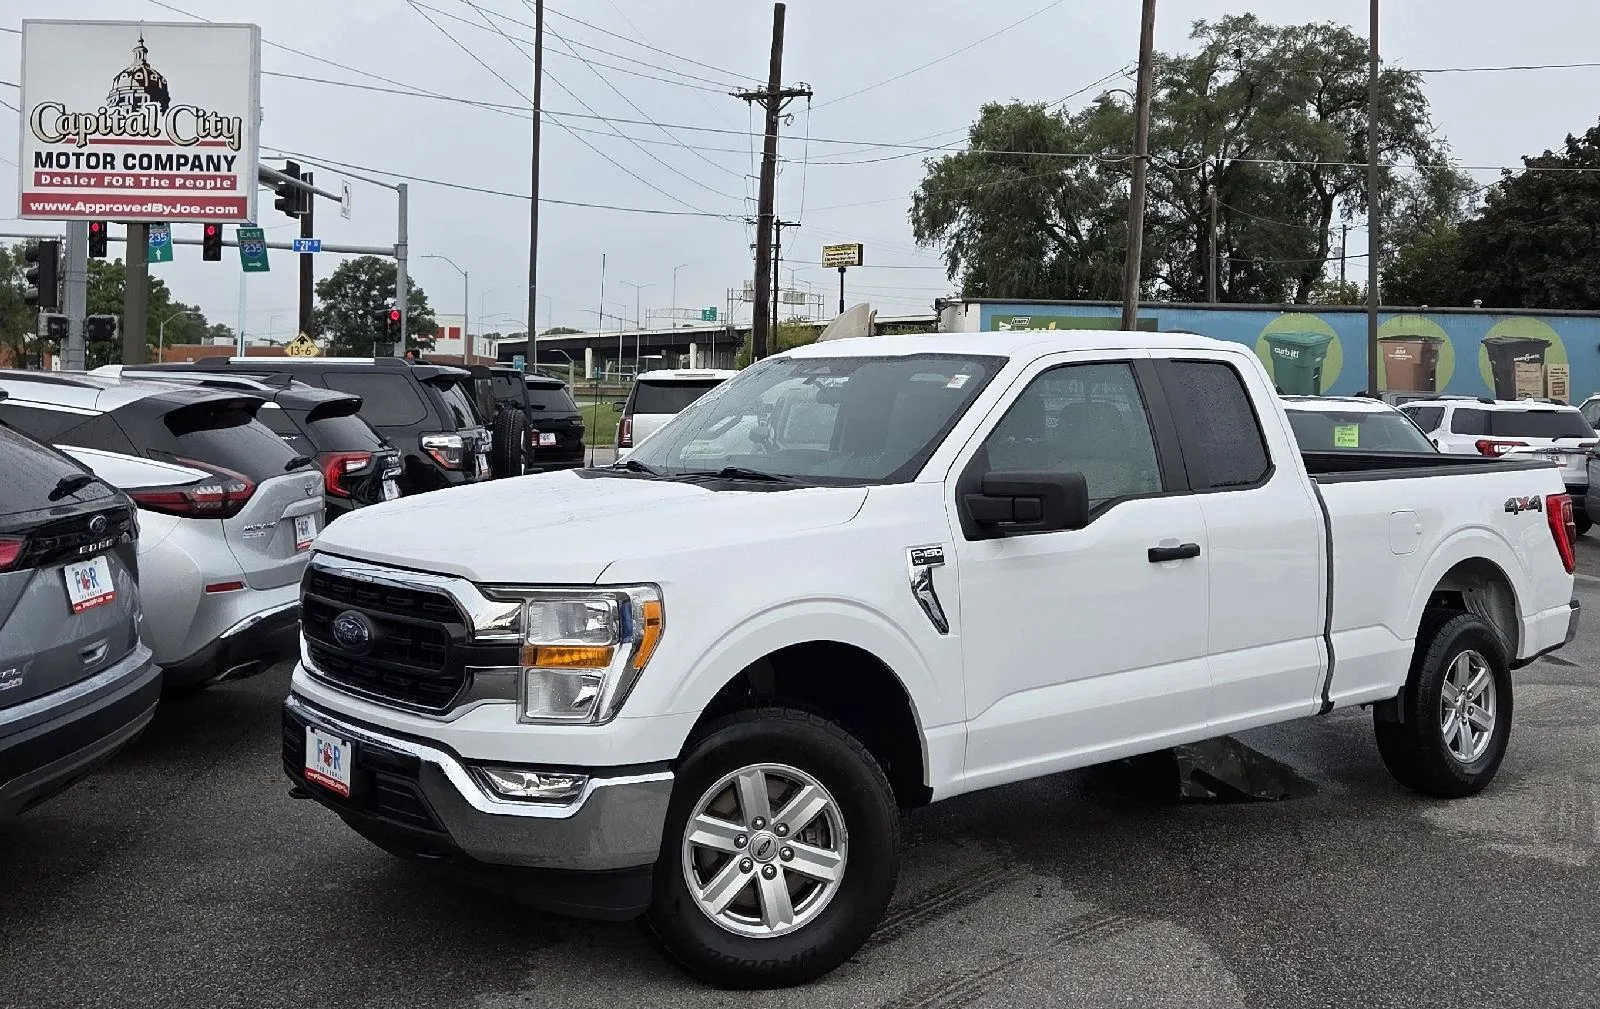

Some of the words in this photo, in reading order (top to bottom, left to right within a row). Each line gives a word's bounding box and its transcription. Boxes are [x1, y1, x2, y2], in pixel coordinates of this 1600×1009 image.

[30, 101, 161, 148] Capital
[165, 104, 242, 151] City
[34, 151, 116, 170] MOTOR
[122, 153, 238, 172] COMPANY
[41, 174, 97, 186] Dealer
[104, 176, 135, 187] FOR
[140, 176, 169, 187] The
[175, 177, 232, 190] People
[29, 201, 238, 215] www.ApprovedByJoe.com
[149, 233, 168, 243] 235
[244, 244, 263, 253] 235
[79, 539, 113, 554] EDGE
